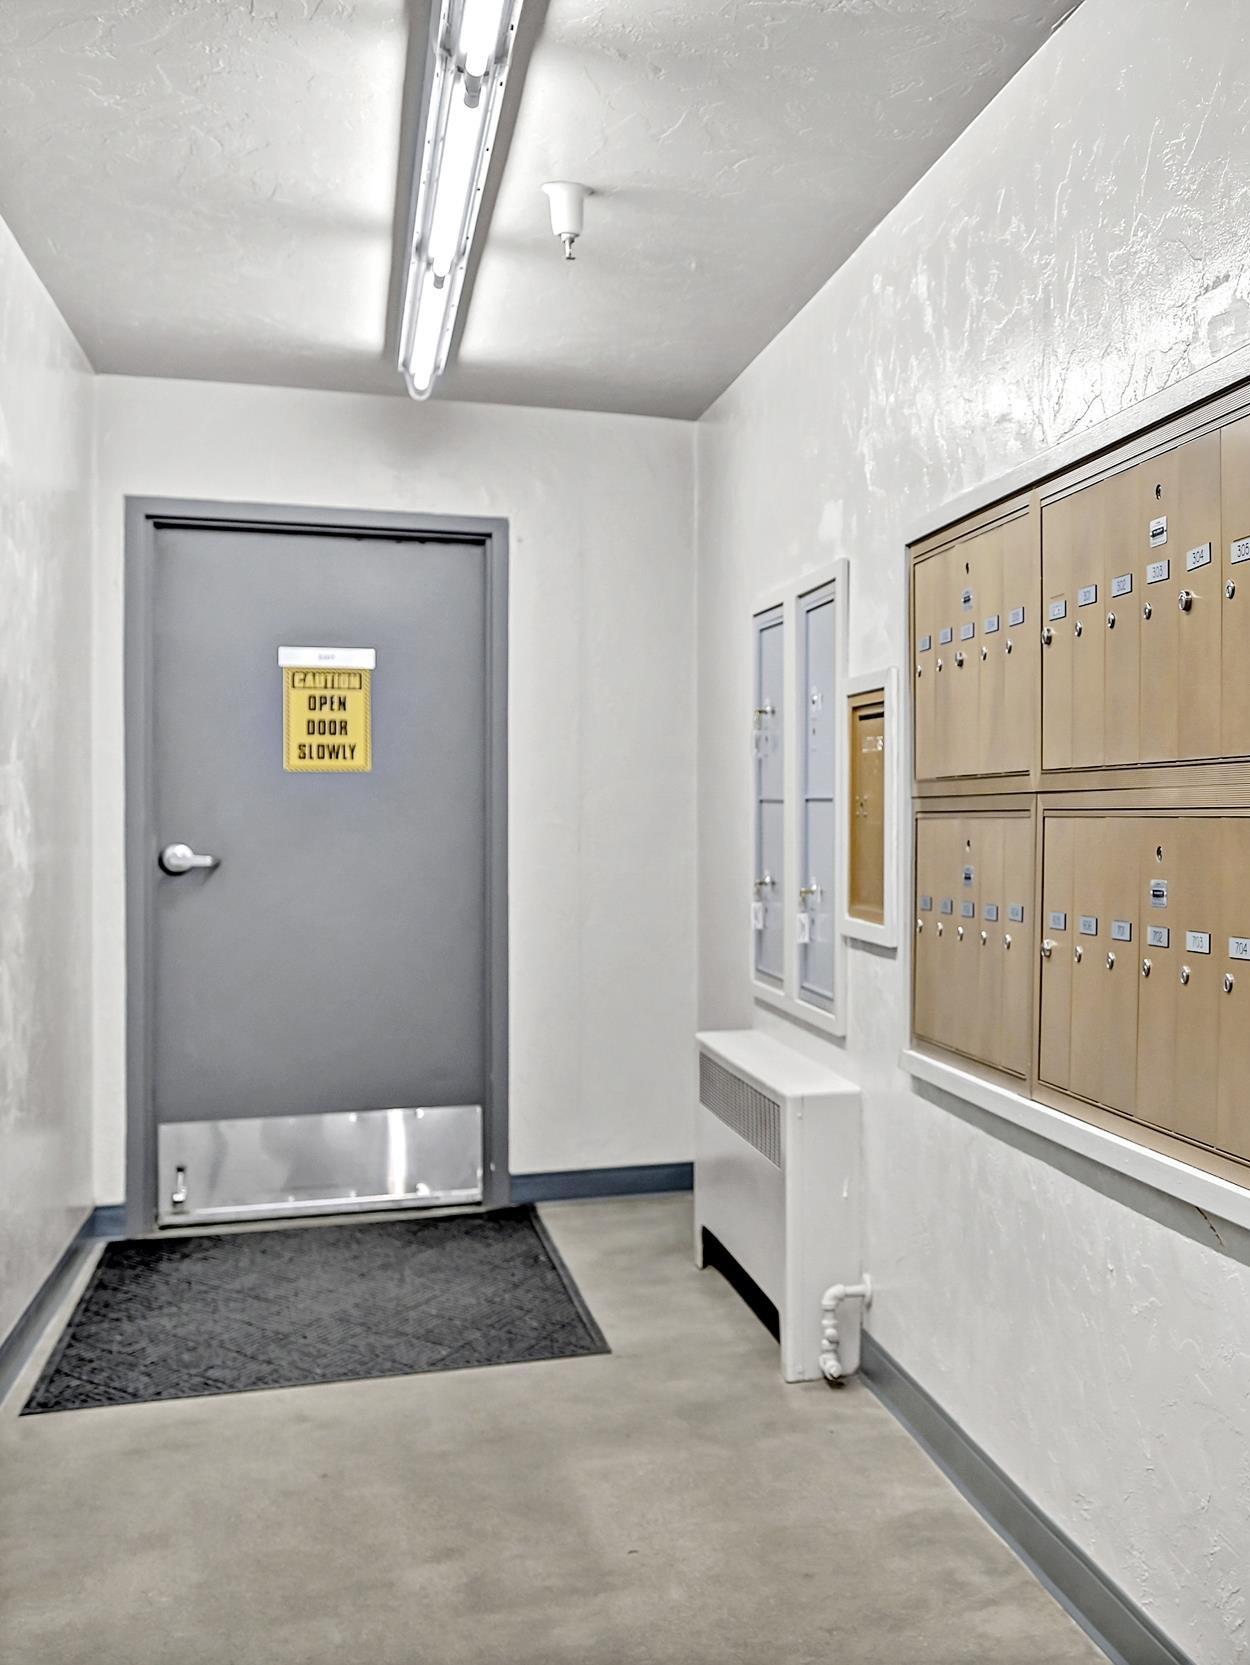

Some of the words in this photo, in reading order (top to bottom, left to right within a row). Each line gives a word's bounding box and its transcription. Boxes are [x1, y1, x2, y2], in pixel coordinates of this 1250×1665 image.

[1192, 549, 1204, 565] 304
[1237, 542, 1250, 557] 305
[292, 671, 362, 690] CAUTION
[308, 695, 347, 711] OPEN
[307, 719, 348, 736] DOOR
[298, 744, 356, 760] SLOWLY
[1152, 930, 1163, 943] 702
[1192, 935, 1204, 949] 703
[1235, 941, 1248, 955] 704
